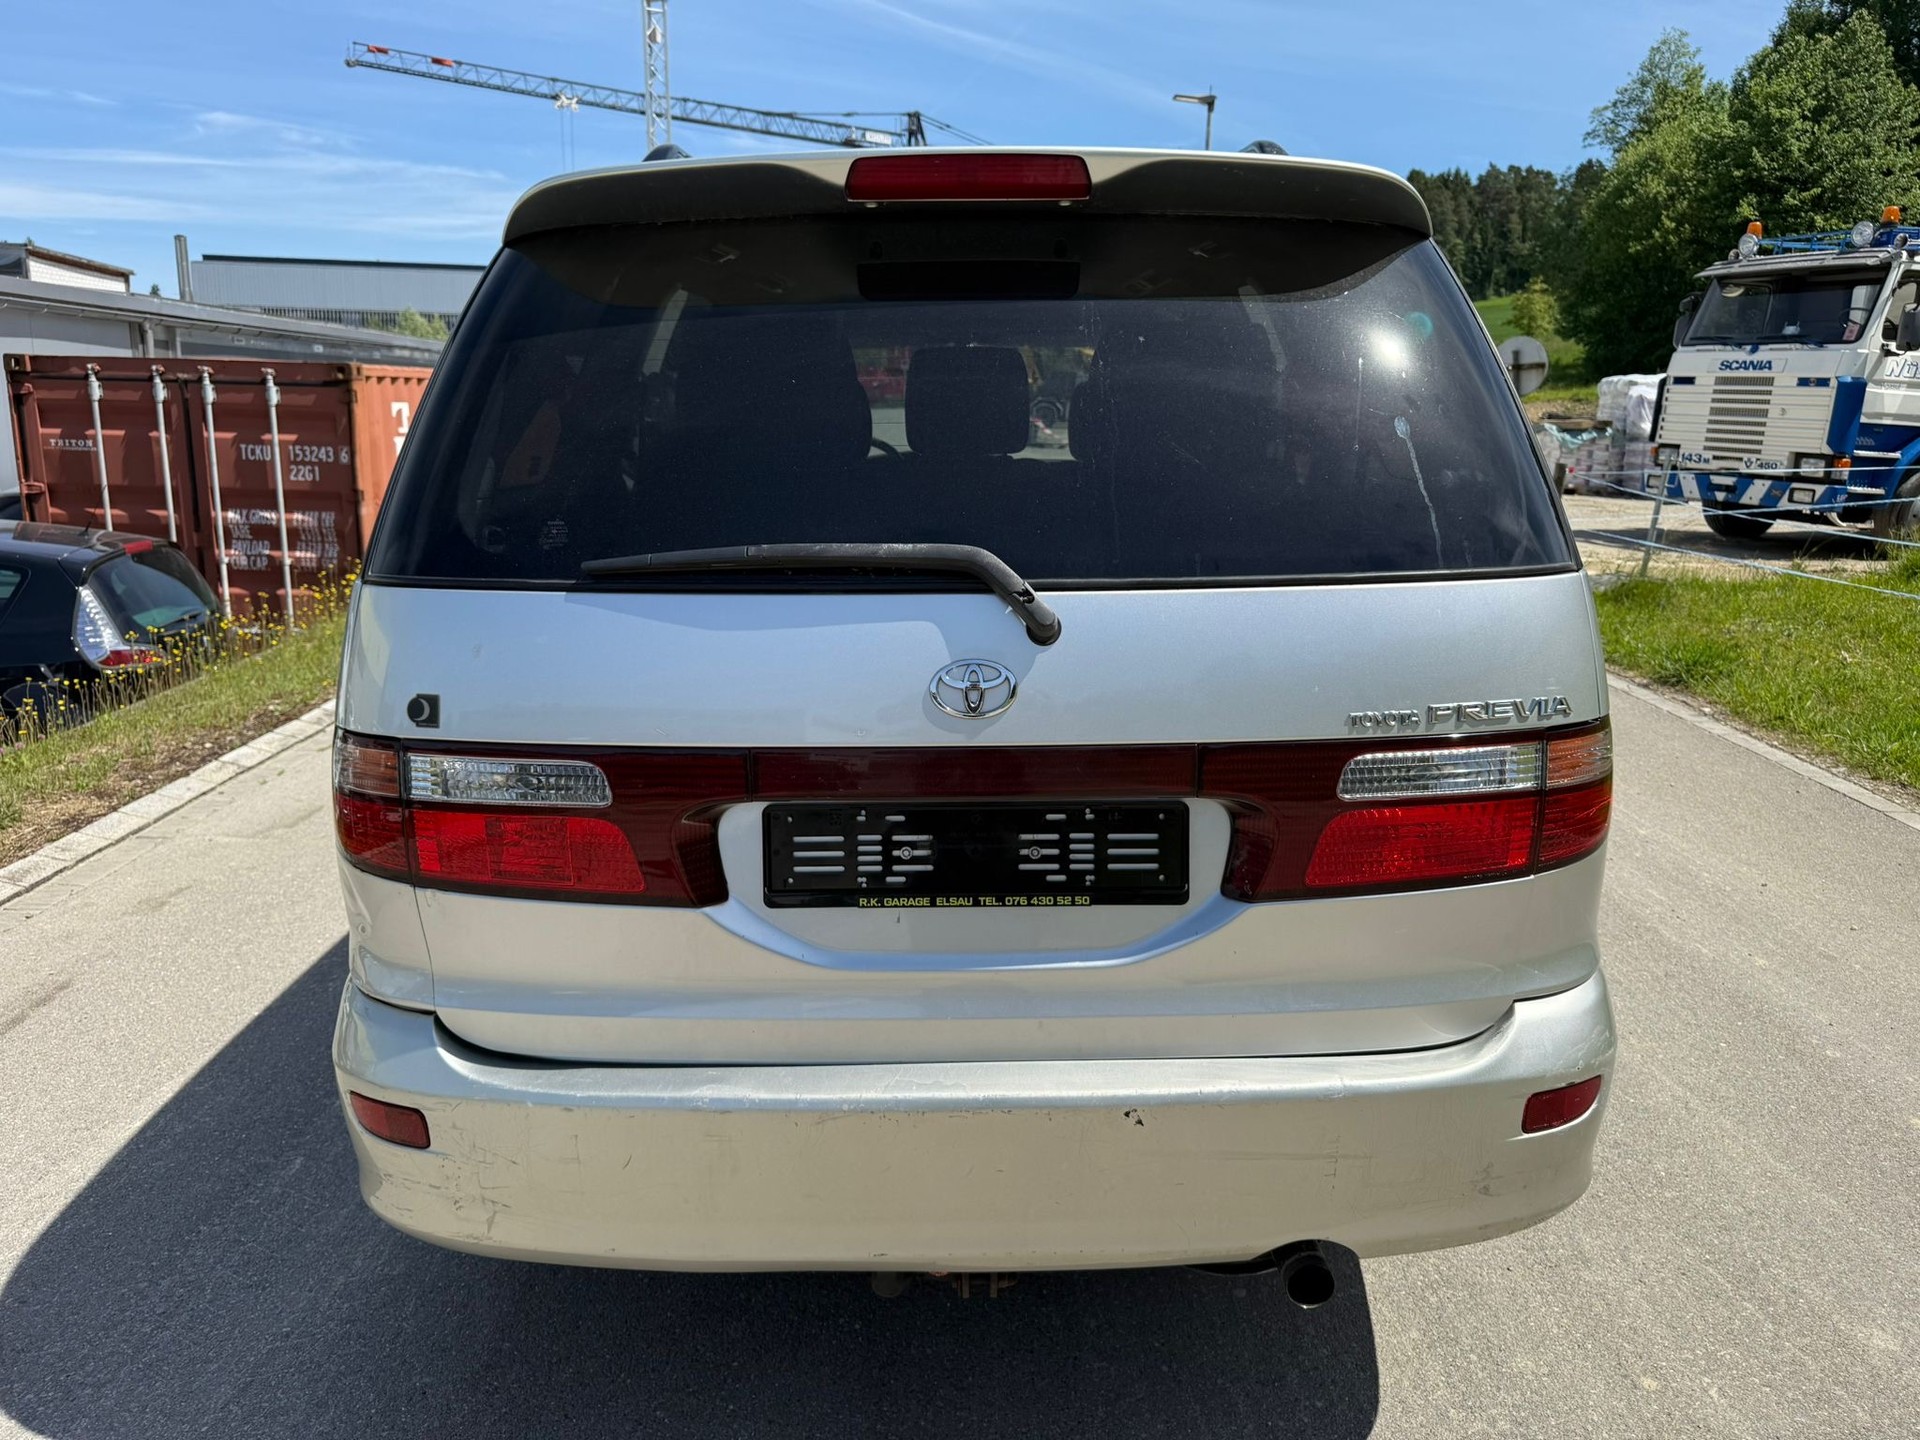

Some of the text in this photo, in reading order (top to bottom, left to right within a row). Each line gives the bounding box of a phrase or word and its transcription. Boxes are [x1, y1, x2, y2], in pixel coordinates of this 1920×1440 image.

[1719, 360, 1772, 371] SCANIA
[49, 438, 93, 447] TRITON
[240, 444, 272, 461] TCKU
[289, 445, 334, 463] 153243
[290, 465, 320, 482] 22G1
[1350, 696, 1573, 728] TOYOTA PREVIA
[859, 896, 1090, 907] R.K. GARAGE ELSAU TEL. 076 430 52 50
